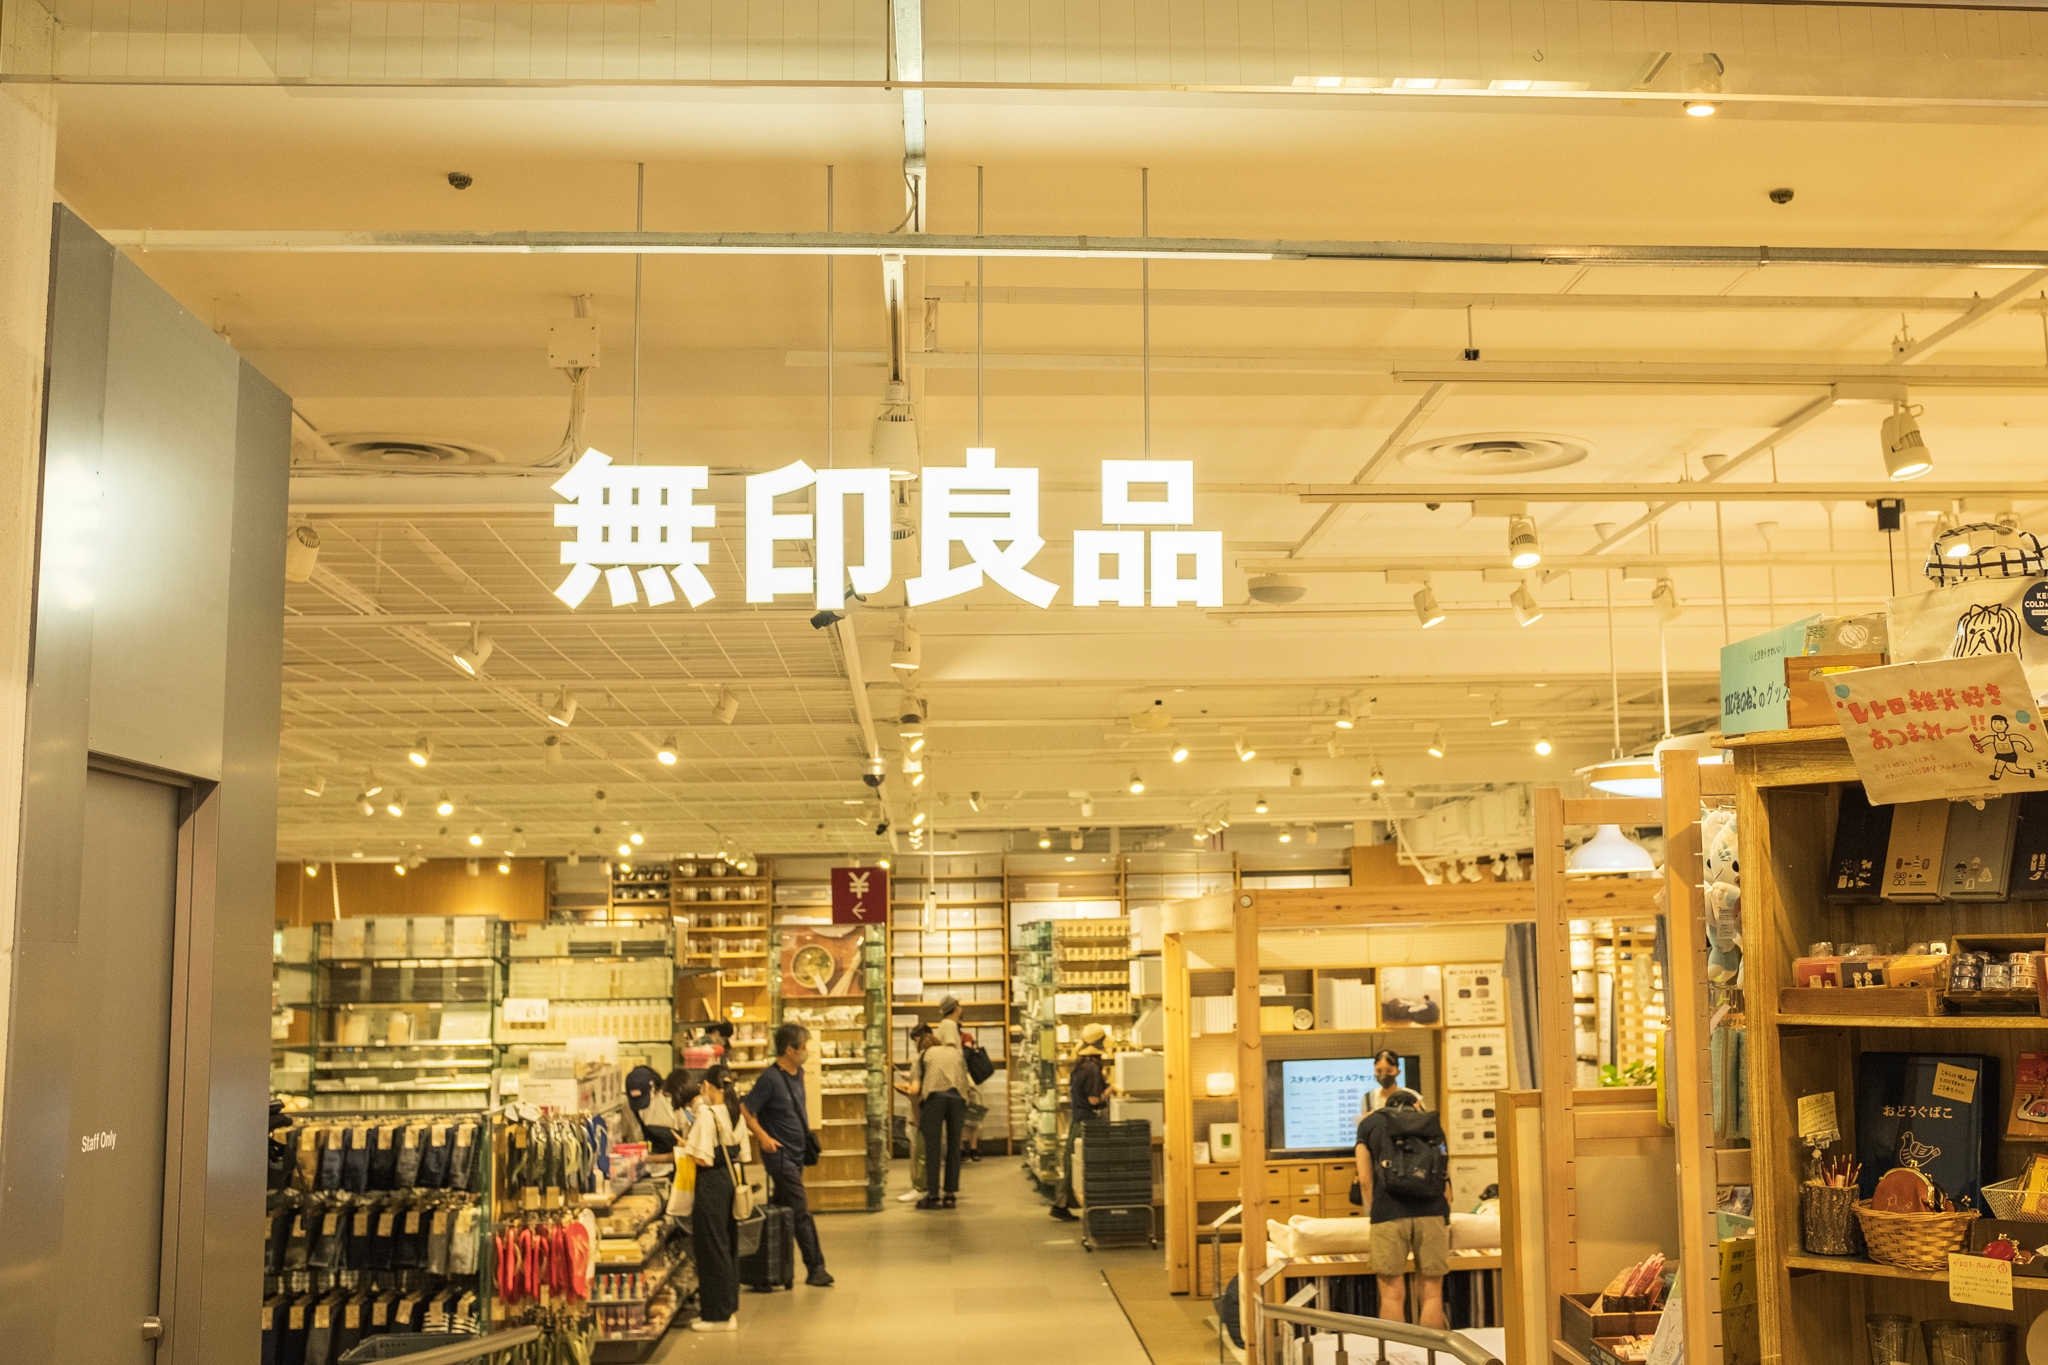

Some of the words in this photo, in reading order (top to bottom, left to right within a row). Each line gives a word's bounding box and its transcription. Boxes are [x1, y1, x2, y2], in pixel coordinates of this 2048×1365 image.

[551, 447, 1223, 610] 無印良品
[2036, 592, 2048, 600] KE
[2025, 600, 2044, 608] COLD
[1847, 683, 2002, 724] レトロ雑貨好き
[1290, 1074, 1374, 1083] スタッキングシェルフセッ
[1883, 1105, 1953, 1119] おどうぐばこ
[81, 1133, 100, 1153] Staff
[100, 1130, 117, 1150] Only
